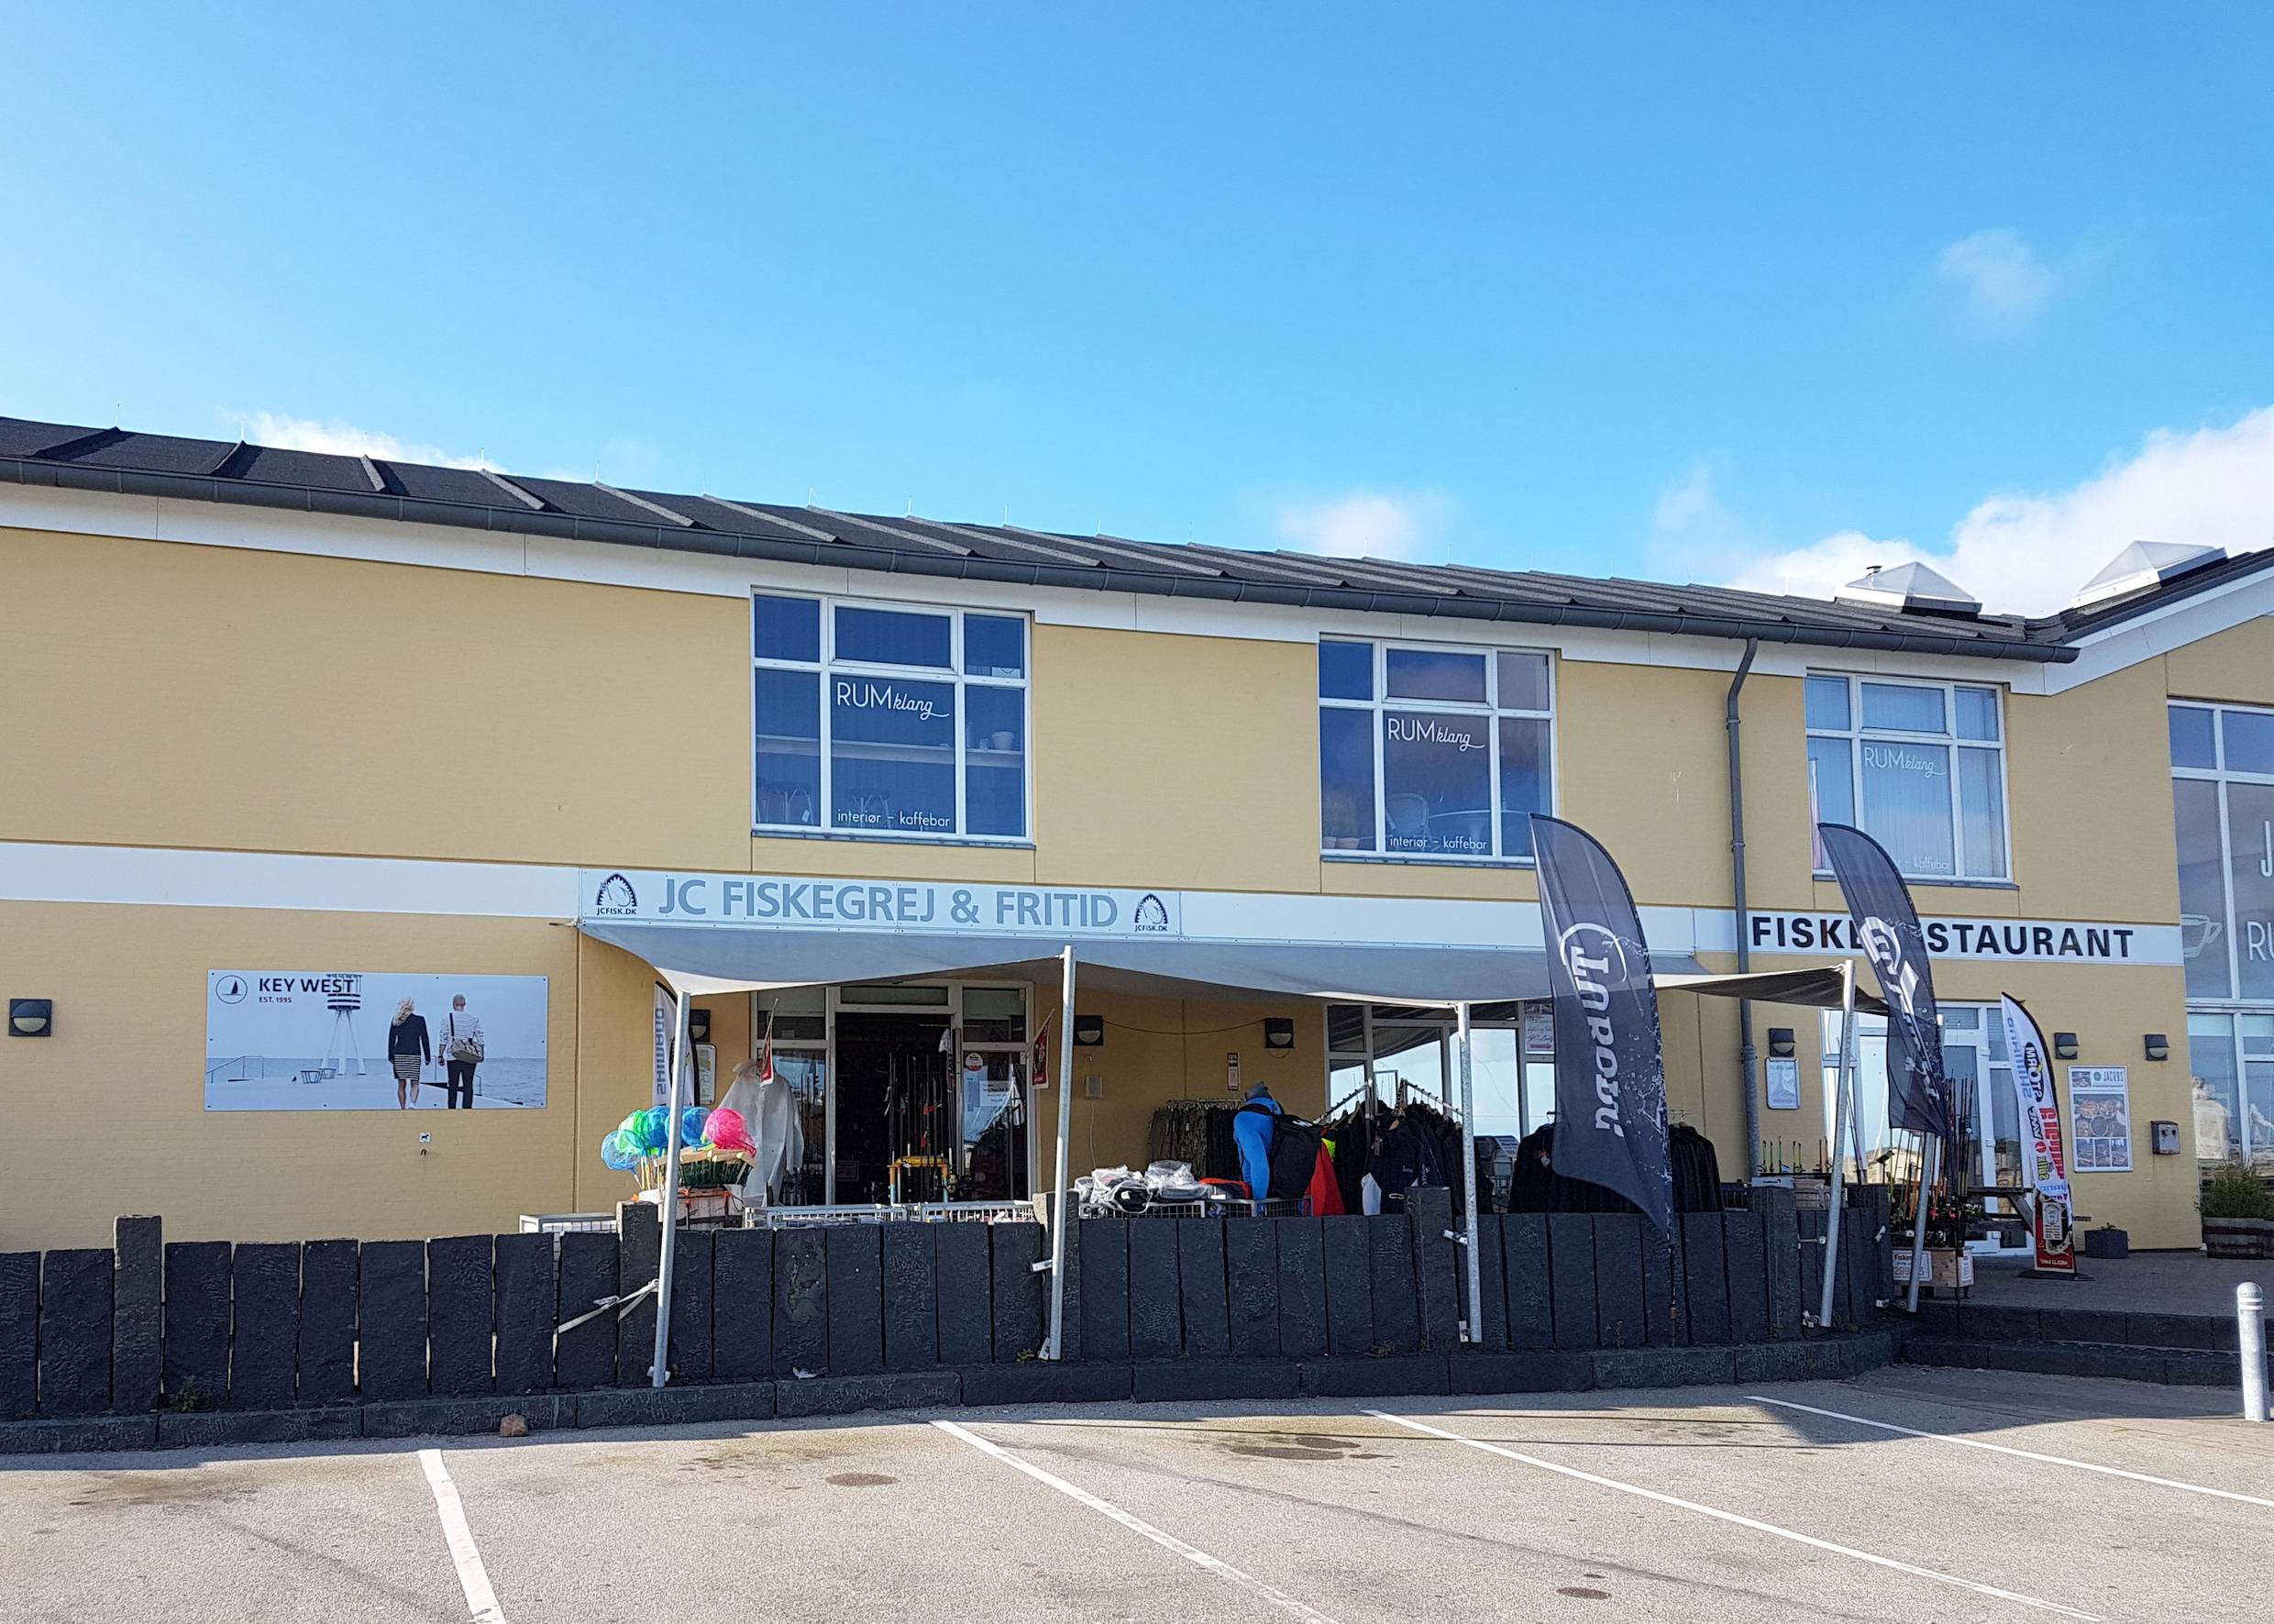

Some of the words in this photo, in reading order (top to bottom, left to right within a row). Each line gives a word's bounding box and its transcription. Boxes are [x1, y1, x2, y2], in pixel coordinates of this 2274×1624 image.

[837, 809, 881, 823] interiør
[900, 811, 951, 827] kaffebar
[1390, 836, 1428, 847] interiør
[1443, 835, 1487, 849] kaffebar
[1914, 856, 1951, 870] kaffebar
[658, 878, 706, 914] JC
[723, 880, 934, 922] FISKEGREJ
[950, 889, 981, 924] &
[996, 890, 1118, 927] FRITID
[596, 907, 637, 916] JCFISK.DK
[259, 978, 295, 992] KEY
[300, 978, 354, 993] WEST
